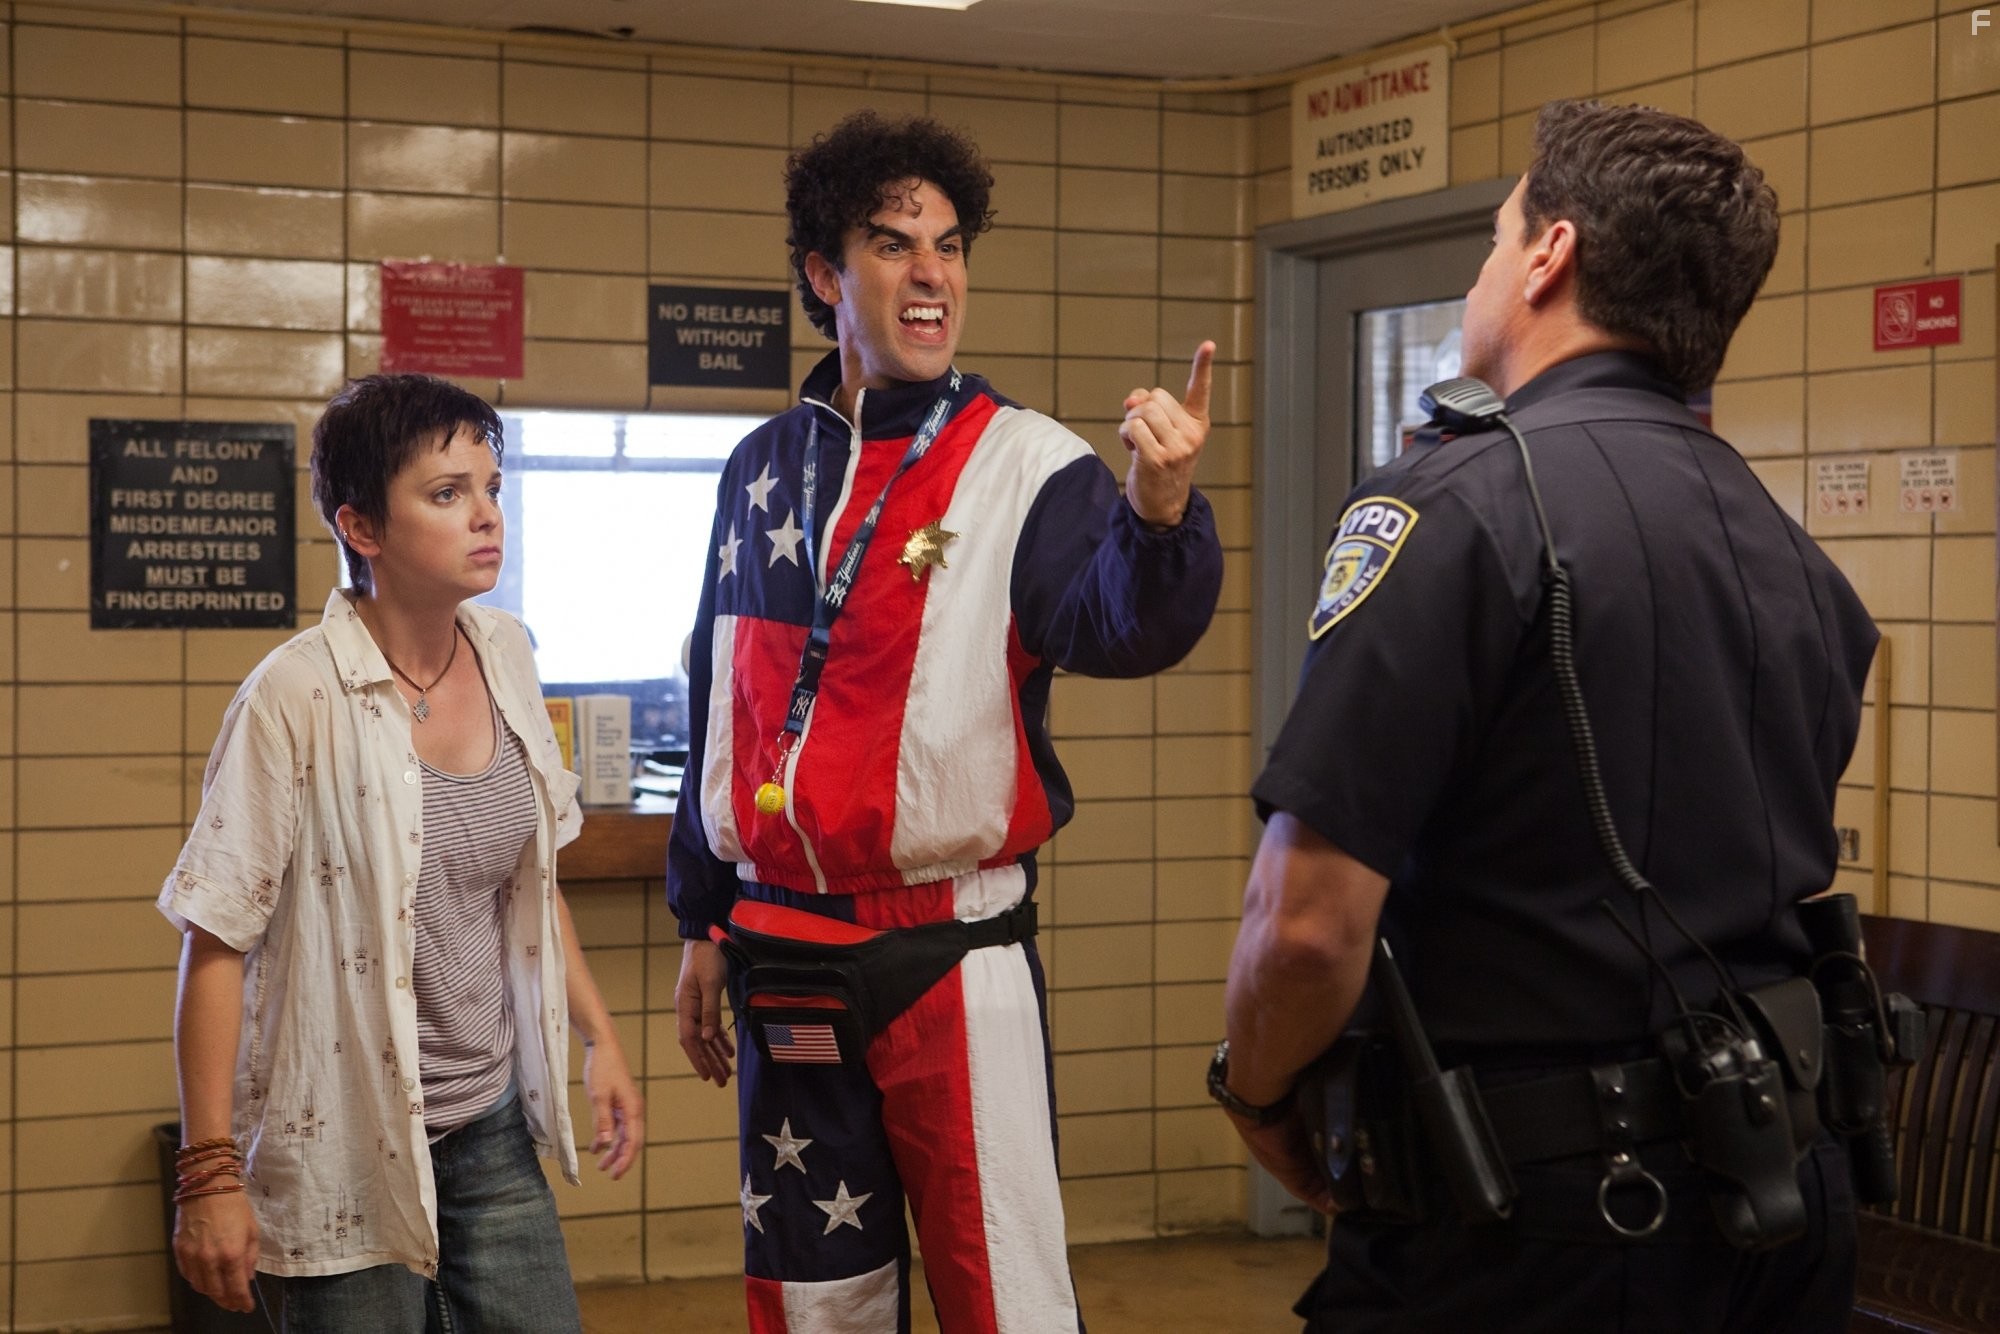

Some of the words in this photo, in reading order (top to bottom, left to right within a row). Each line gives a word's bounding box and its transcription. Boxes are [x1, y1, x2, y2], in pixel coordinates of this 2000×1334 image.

[1307, 90, 1328, 121] NO
[1333, 61, 1430, 114] ADMITTANCE
[1316, 117, 1413, 160] AUTHORIZED
[1308, 160, 1370, 195] PERSONS
[1379, 147, 1426, 177] ONLY
[1929, 295, 1944, 309] NO
[658, 304, 688, 320] NO
[694, 305, 782, 325] RELEASE
[1916, 314, 1957, 331] SMOKING
[676, 328, 765, 348] WITHOUT
[699, 352, 744, 370] BAIL
[124, 439, 167, 458] ALL
[174, 441, 264, 460] FELONY
[171, 466, 218, 484] AND
[111, 489, 176, 509] FIRST
[184, 491, 275, 511] DEGREE
[110, 515, 277, 536] MISDEMEANOR
[127, 541, 261, 560] ARRESTEES
[836, 541, 863, 584] Yankees
[146, 566, 208, 586] MUST
[216, 567, 246, 585] BE
[106, 591, 285, 611] FINGERPRINTED
